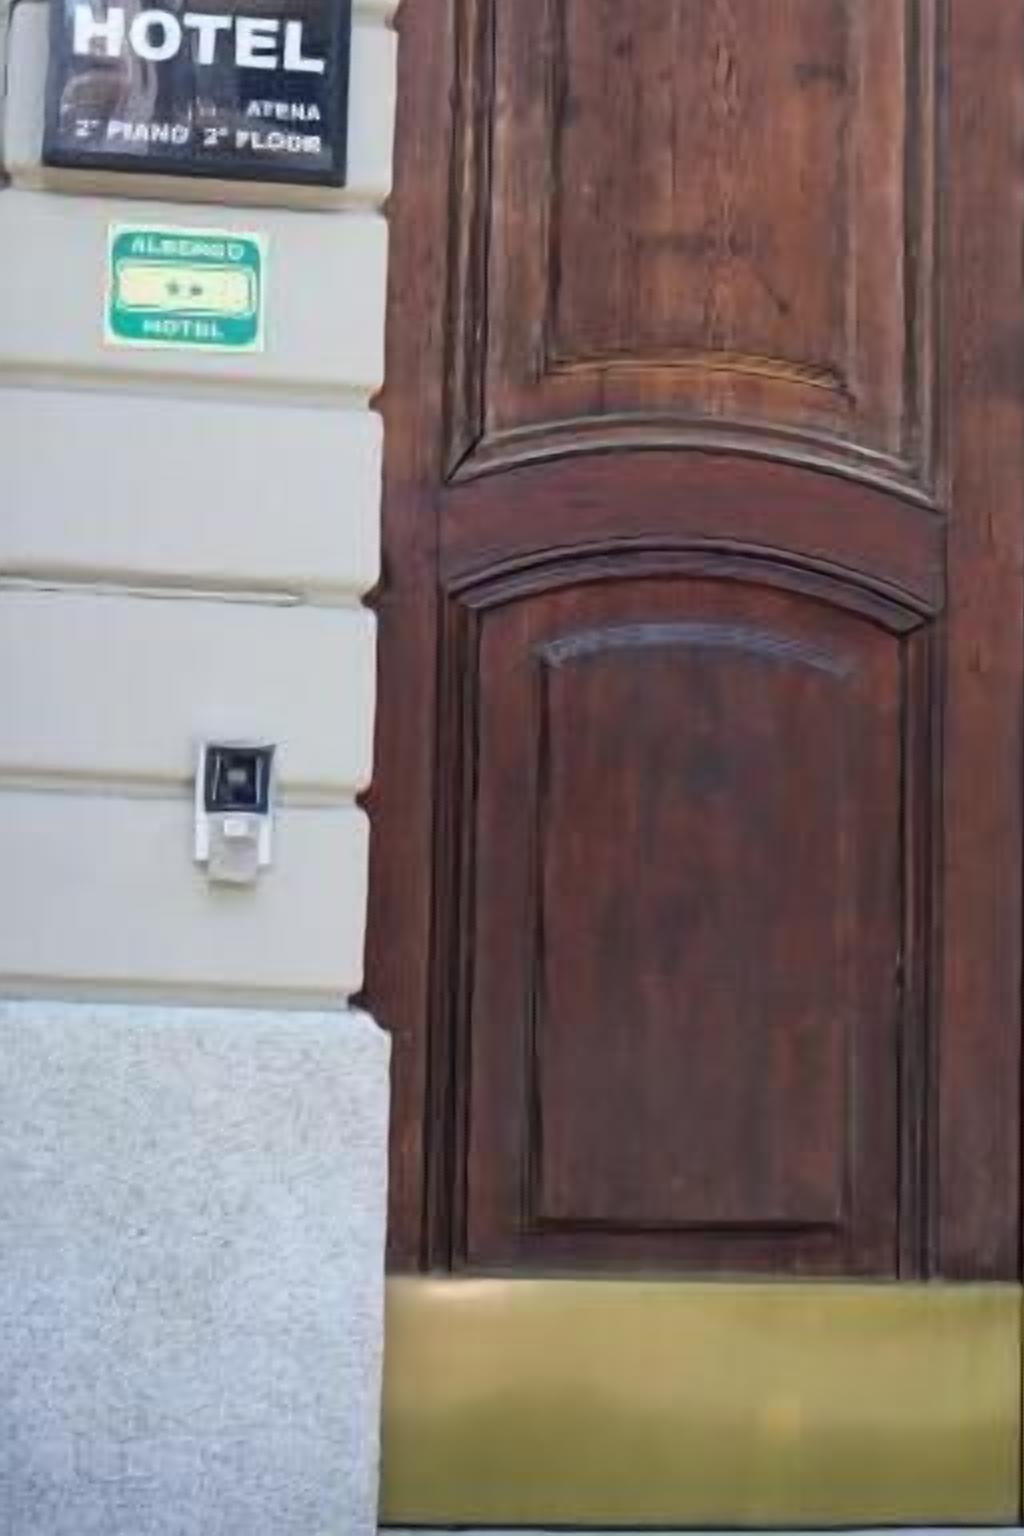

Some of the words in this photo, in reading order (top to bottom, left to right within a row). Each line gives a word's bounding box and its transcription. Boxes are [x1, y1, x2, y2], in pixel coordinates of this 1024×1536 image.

[72, 4, 326, 75] HOTEL
[246, 99, 322, 122] ATENA
[106, 120, 190, 145] PIANO
[235, 130, 322, 155] FLOOR
